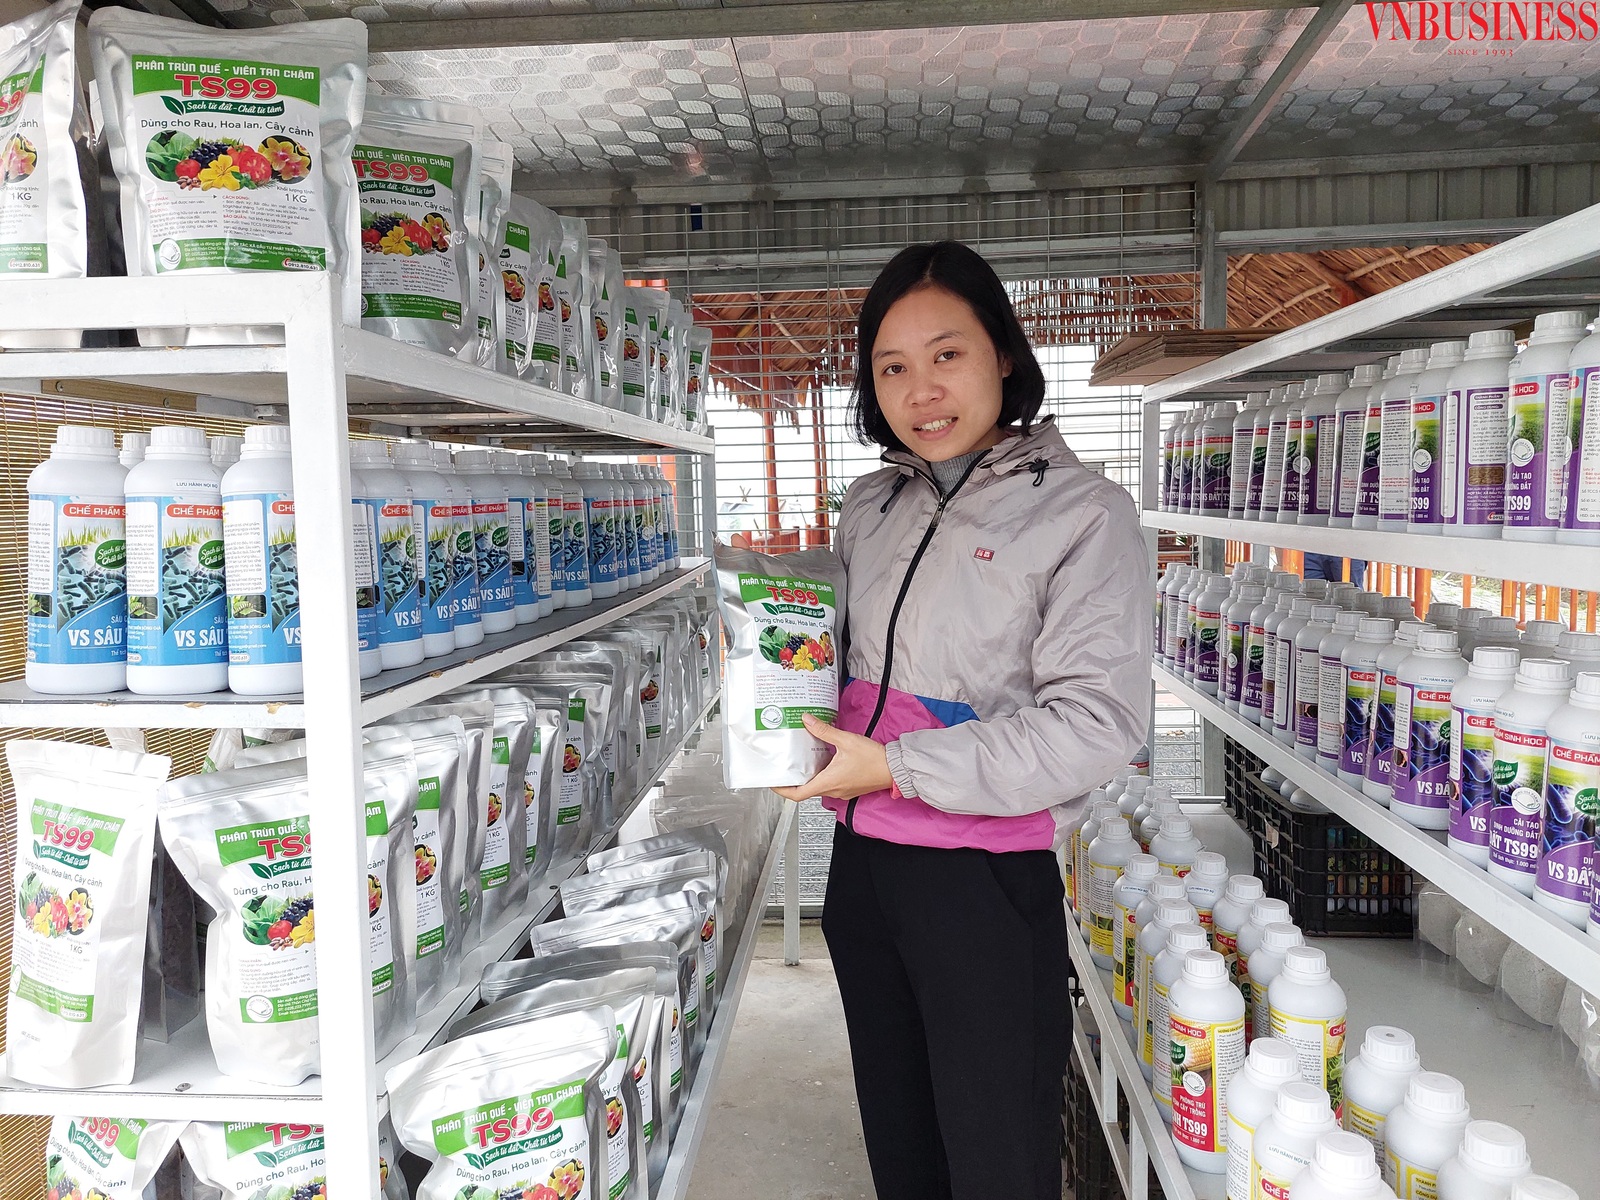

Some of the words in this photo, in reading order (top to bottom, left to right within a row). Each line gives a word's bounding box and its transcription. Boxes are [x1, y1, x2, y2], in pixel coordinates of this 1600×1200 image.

[135, 61, 165, 71] PHÂN
[168, 61, 196, 72] TRÙN
[200, 63, 221, 74] QUẾ
[233, 64, 257, 76] VIÊN
[260, 67, 280, 77] TAN
[284, 69, 315, 81] CHẬM
[174, 74, 278, 100] TS99
[187, 102, 206, 113] Sạch
[219, 102, 232, 111] đất
[267, 105, 283, 114] tâm
[141, 119, 168, 129] Dùng
[171, 119, 191, 127] cho
[194, 120, 217, 129] Rau,
[220, 121, 240, 129] Hoa
[244, 121, 262, 130] lan,
[265, 121, 286, 134] Cây
[289, 126, 314, 138] cảnh
[367, 150, 383, 160] QUẾ
[392, 153, 410, 162] VIÊN
[412, 156, 428, 165] TAN
[430, 158, 451, 169] CHẬM
[352, 159, 429, 182] TS99
[17, 192, 32, 201] KG
[285, 193, 290, 202] 1
[292, 194, 308, 204] KG
[370, 197, 389, 205] Rau,
[390, 198, 406, 206] Hoa
[424, 201, 438, 211] Cây
[440, 204, 452, 214] cảnh
[1518, 385, 1534, 394] HỌC
[1520, 472, 1532, 481] TẠO
[1520, 482, 1531, 491] ĐẤT
[1506, 496, 1531, 510] TS99
[69, 504, 92, 515] CHẾ
[93, 505, 120, 516] PHẨM
[173, 505, 194, 516] CHẾ
[196, 506, 220, 516] PHẨM
[386, 506, 400, 515] CHẾ
[97, 546, 114, 560] Sạch
[201, 547, 216, 560] Sạch
[565, 571, 576, 581] VS
[741, 577, 759, 586] PHÂN
[480, 589, 494, 601] VS
[495, 585, 510, 600] SÂU
[766, 586, 819, 606] TS99
[462, 595, 476, 610] SÂU
[437, 605, 449, 619] VS
[394, 611, 409, 627] VS
[754, 616, 772, 624] Dùng
[68, 629, 90, 646] VS
[94, 625, 122, 646] SÂU
[174, 629, 196, 647] VS
[199, 626, 224, 646] SÂU
[1353, 672, 1366, 680] CHẾ
[1421, 690, 1436, 700] CHẾ
[1471, 716, 1487, 727] CHẾ
[1504, 733, 1522, 743] SINH
[1524, 736, 1543, 746] HỌC
[1351, 751, 1364, 763] VS
[1556, 748, 1572, 759] CHẾ
[1378, 760, 1391, 772] VS
[1417, 780, 1432, 795] VS
[1577, 794, 1595, 806] Sạch
[1470, 816, 1487, 830] VS
[1513, 818, 1524, 826] CẢI
[1526, 821, 1539, 830] TẠO
[42, 820, 96, 852] TS99
[220, 831, 248, 844] PHÂN
[250, 827, 275, 839] TRÙN
[278, 820, 298, 836] QUẾ
[420, 829, 436, 841] cảnh
[1504, 823, 1524, 836] DƯỠNG
[1526, 830, 1538, 840] ĐẤT
[1504, 839, 1538, 858] TS99
[272, 862, 290, 873] Sạch
[368, 858, 386, 870] cảnh
[1548, 860, 1564, 879] VS
[51, 868, 62, 878] Hoa
[74, 873, 86, 885] Cây
[86, 876, 103, 888] cảnh
[233, 887, 258, 896] Dùng
[261, 882, 280, 892] cho
[282, 880, 302, 888] Rau,
[425, 889, 436, 898] KG
[371, 923, 382, 933] KG
[74, 945, 83, 955] KG
[1187, 1028, 1202, 1038] HỌC
[436, 1119, 462, 1136] PHÂN
[463, 1110, 488, 1125] TRÙN
[490, 1102, 506, 1119] QUẾ
[513, 1098, 534, 1112] VIÊN
[536, 1093, 554, 1106] TAN
[555, 1084, 583, 1103] CHẬM
[1190, 1106, 1206, 1118] TRỒNG
[471, 1107, 554, 1150] TS99
[1182, 1117, 1208, 1137] TS99
[278, 1148, 297, 1159] Sạch
[307, 1139, 320, 1150] đất
[485, 1150, 500, 1162] Sạch
[548, 1132, 562, 1143] tâm
[616, 1139, 624, 1149] KG
[456, 1167, 474, 1182] Dùng
[476, 1173, 491, 1182] cho
[492, 1166, 510, 1179] Rau,
[511, 1160, 530, 1172] Hoa
[531, 1156, 548, 1166] lan,
[550, 1149, 567, 1160] Cây
[568, 1140, 587, 1154] cảnh
[102, 1180, 127, 1188] cảnh
[236, 1177, 264, 1191] Dùng
[266, 1171, 285, 1181] cho
[287, 1164, 308, 1175] Rau,
[1264, 1182, 1280, 1196] CHẾ
